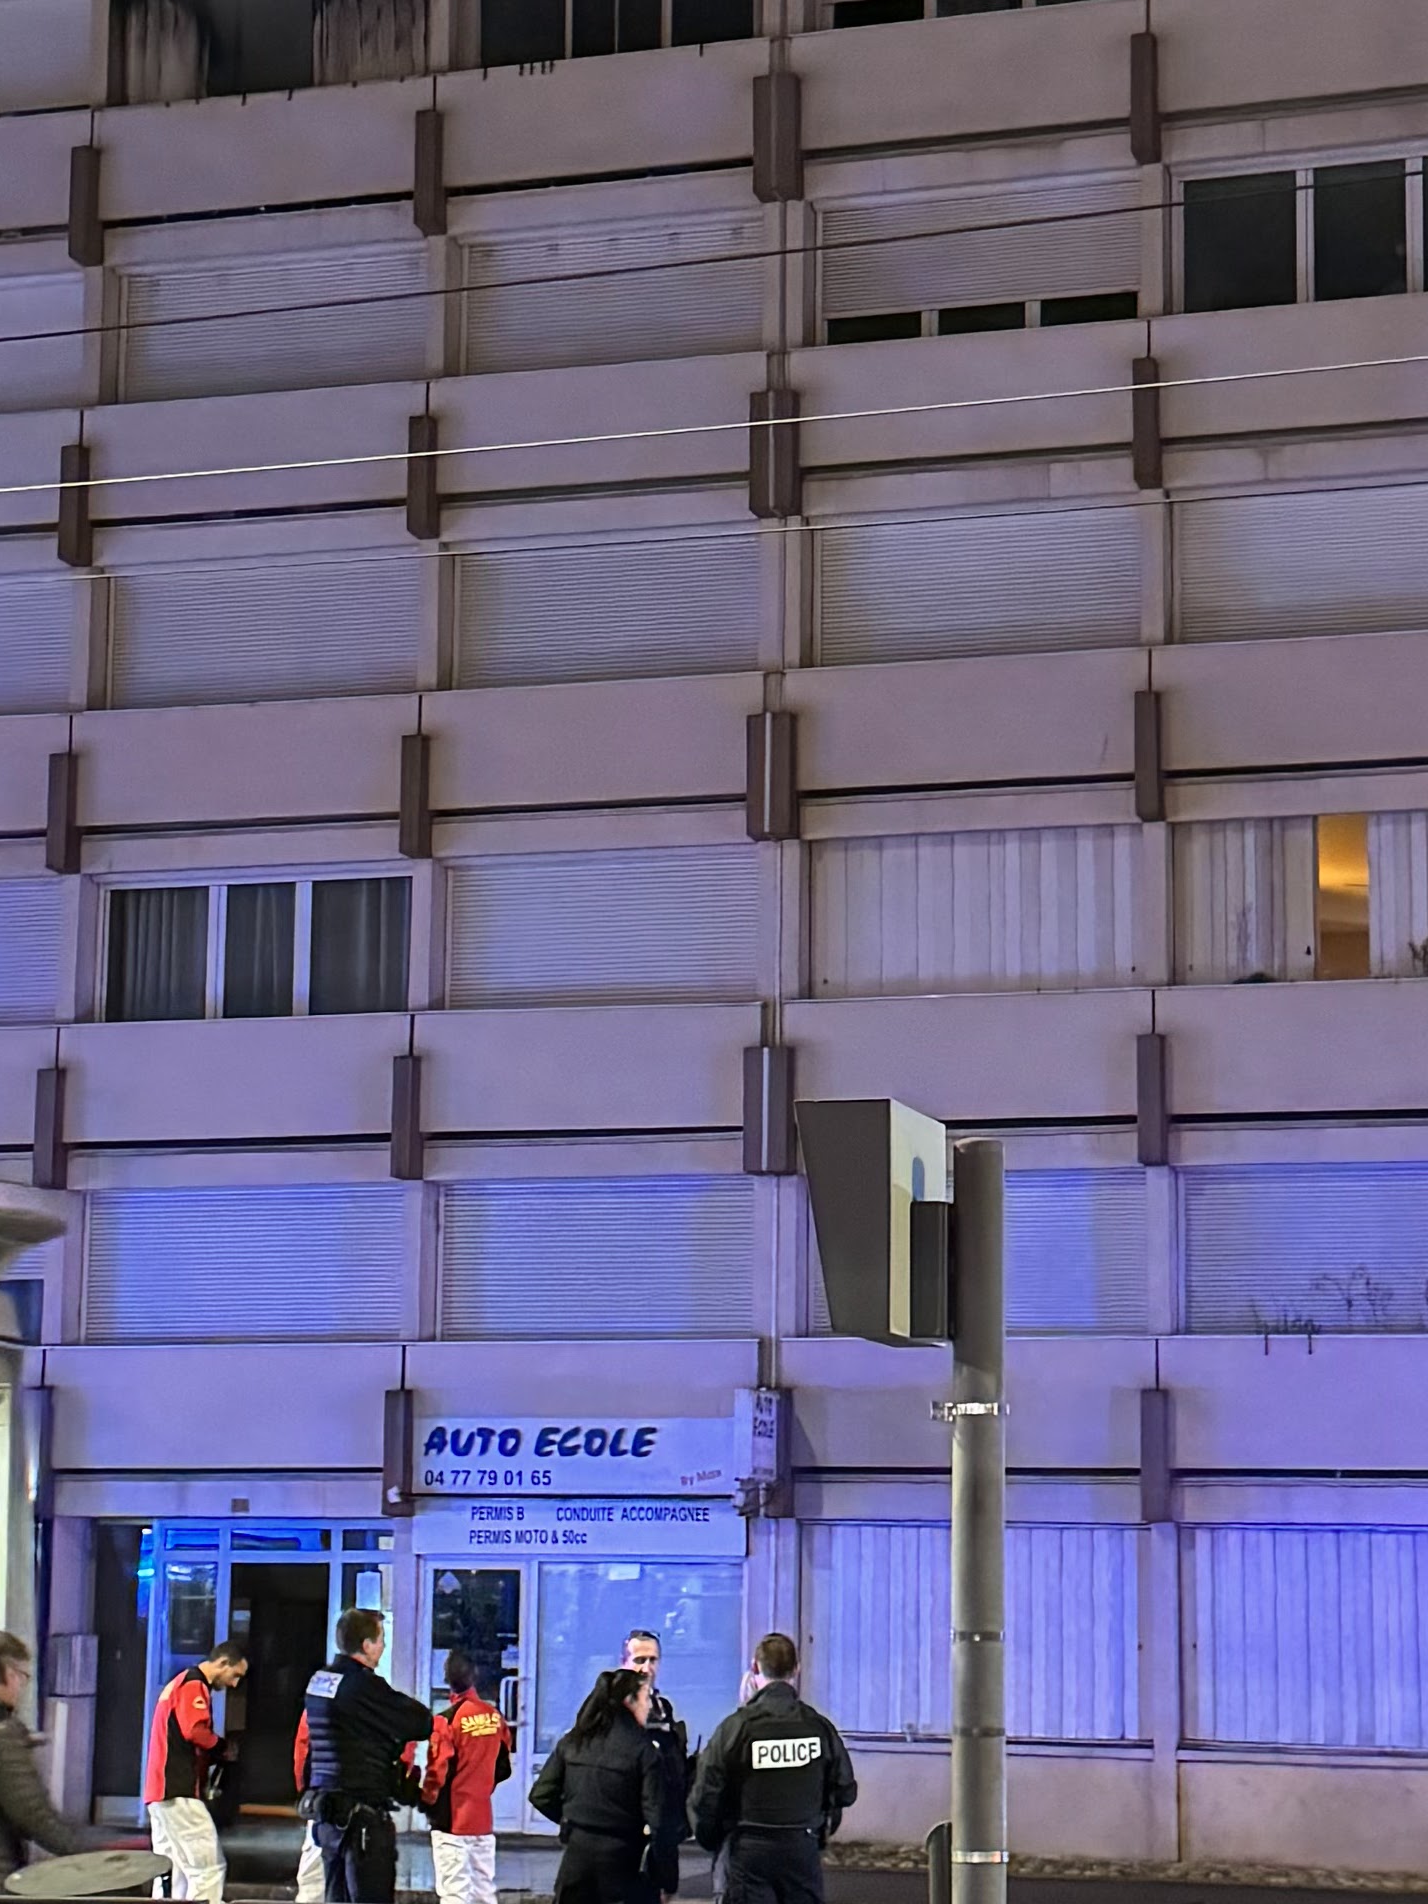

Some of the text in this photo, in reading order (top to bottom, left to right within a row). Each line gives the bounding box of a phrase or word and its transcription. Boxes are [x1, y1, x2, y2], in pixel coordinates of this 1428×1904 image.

[424, 1426, 658, 1457] AUTO ECOLE
[424, 1469, 552, 1486] 04 77 79 01 65
[472, 1506, 710, 1522] PERMIS B CONDUITE ACCOMPAGNEE
[469, 1529, 587, 1544] PERMIS MOTO & 50cc
[758, 1742, 818, 1765] POLICE
